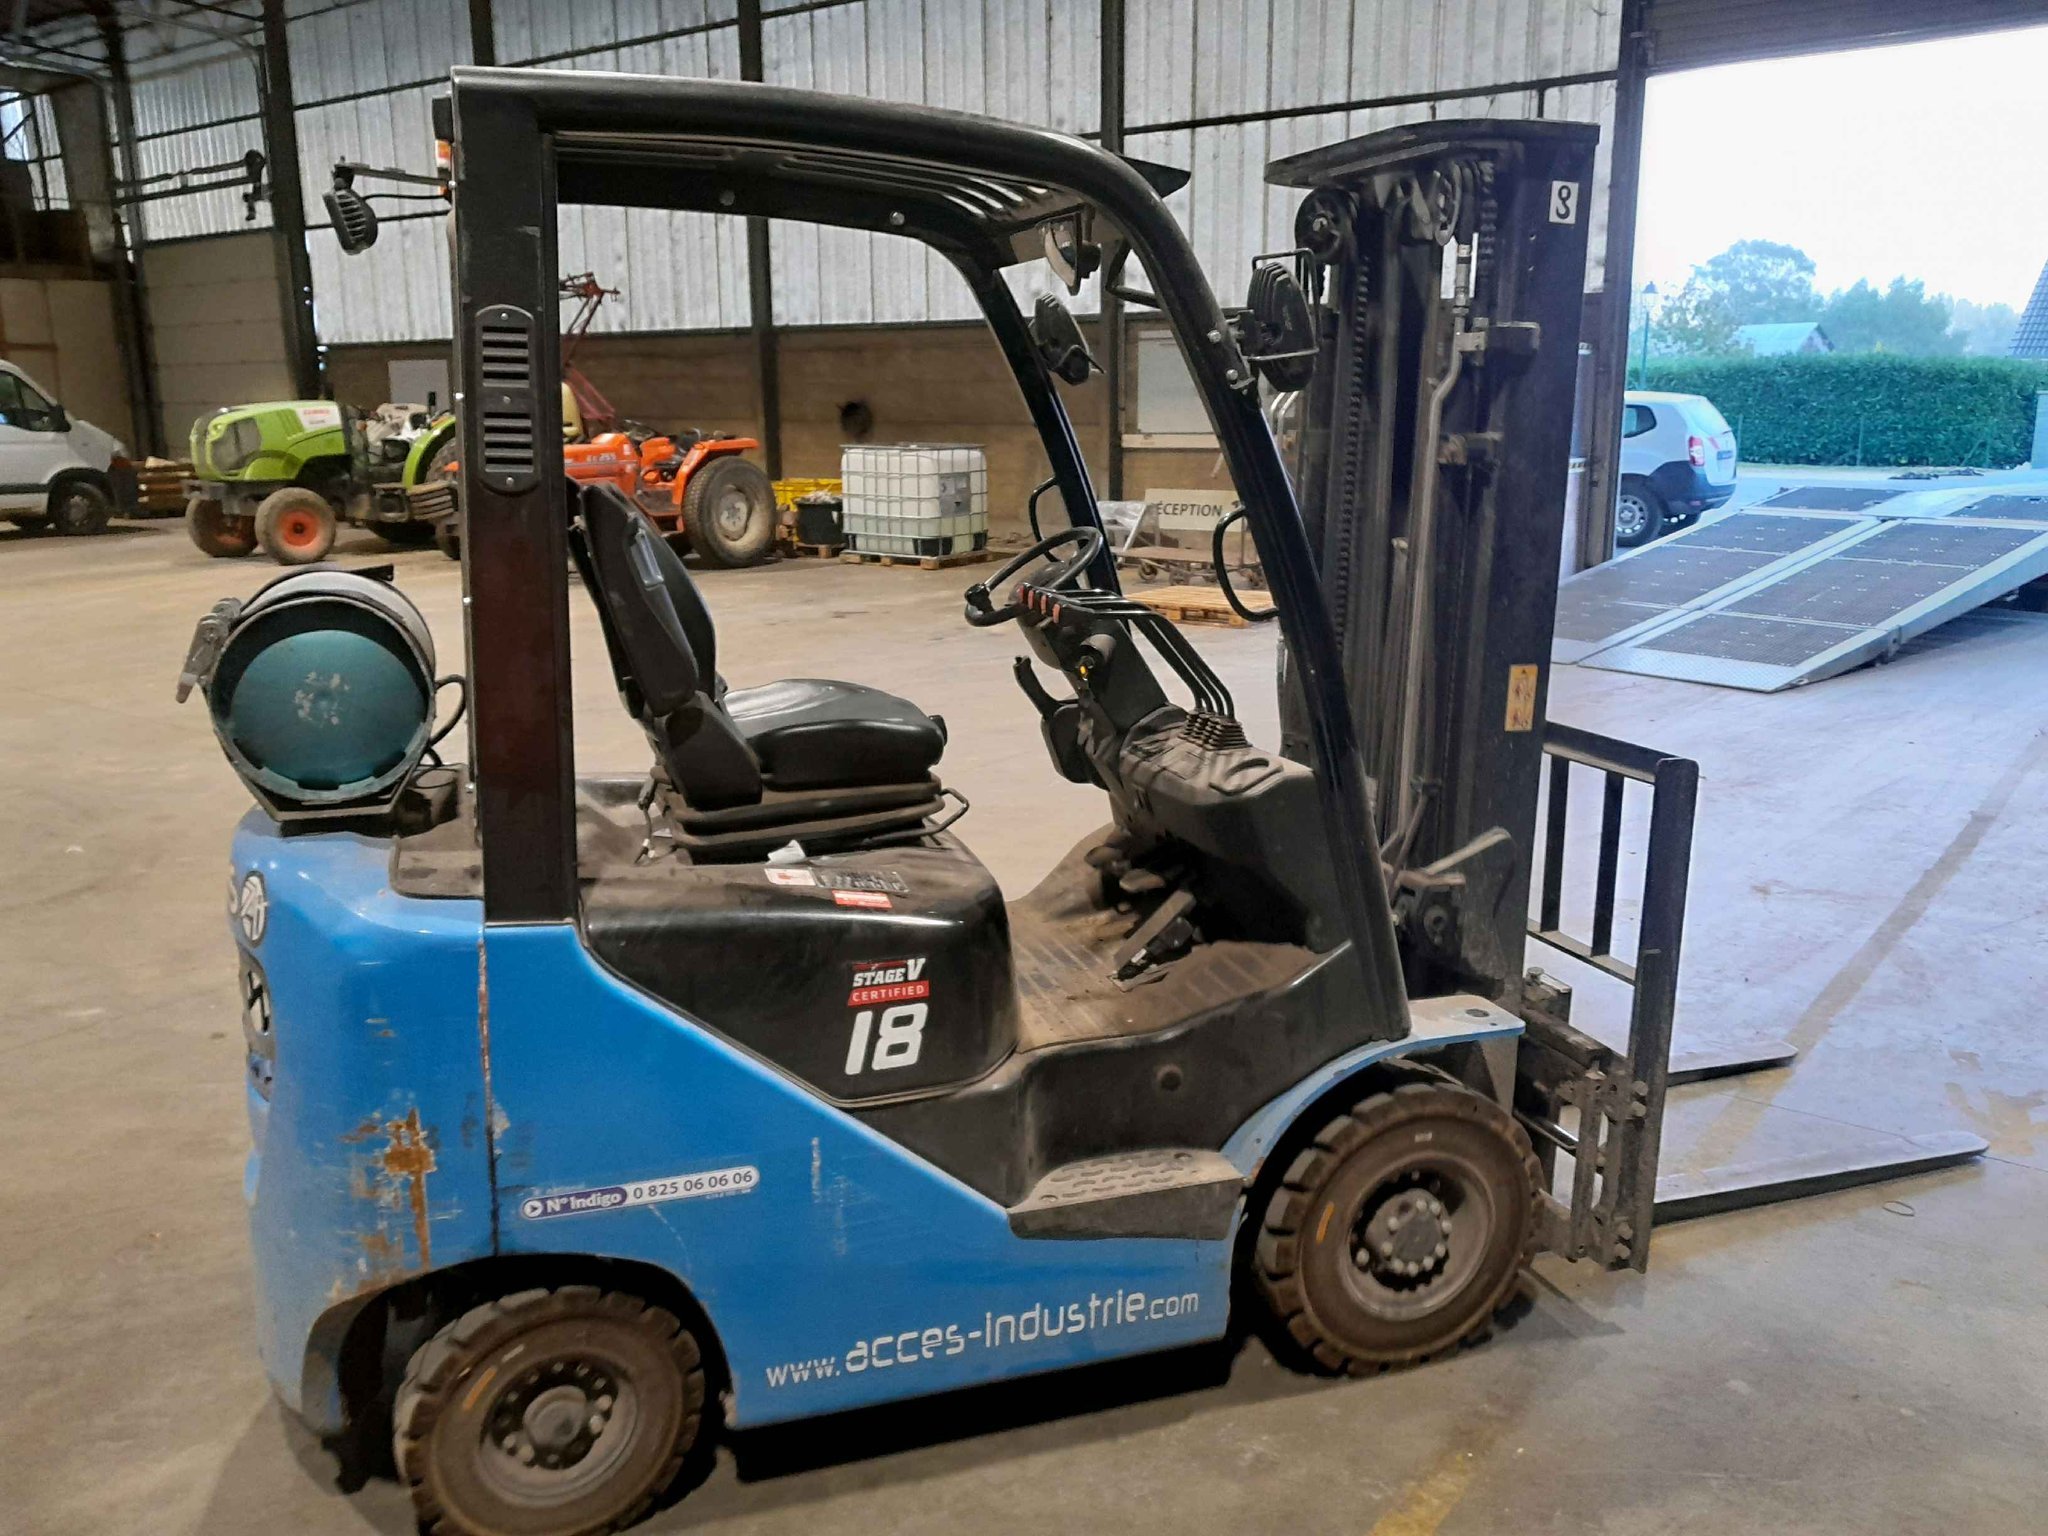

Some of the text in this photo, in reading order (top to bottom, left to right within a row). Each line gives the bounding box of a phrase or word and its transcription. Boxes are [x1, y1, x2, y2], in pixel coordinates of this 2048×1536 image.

[1150, 501, 1222, 517] ÉCEPTION
[852, 985, 925, 1002] CERTIFIED
[845, 1002, 929, 1076] 18
[570, 1192, 621, 1210] Indigo
[633, 1187, 643, 1199] 0
[648, 1181, 678, 1198] 825
[683, 1178, 704, 1192] 06
[708, 1174, 728, 1188] 06
[732, 1170, 753, 1184] 06
